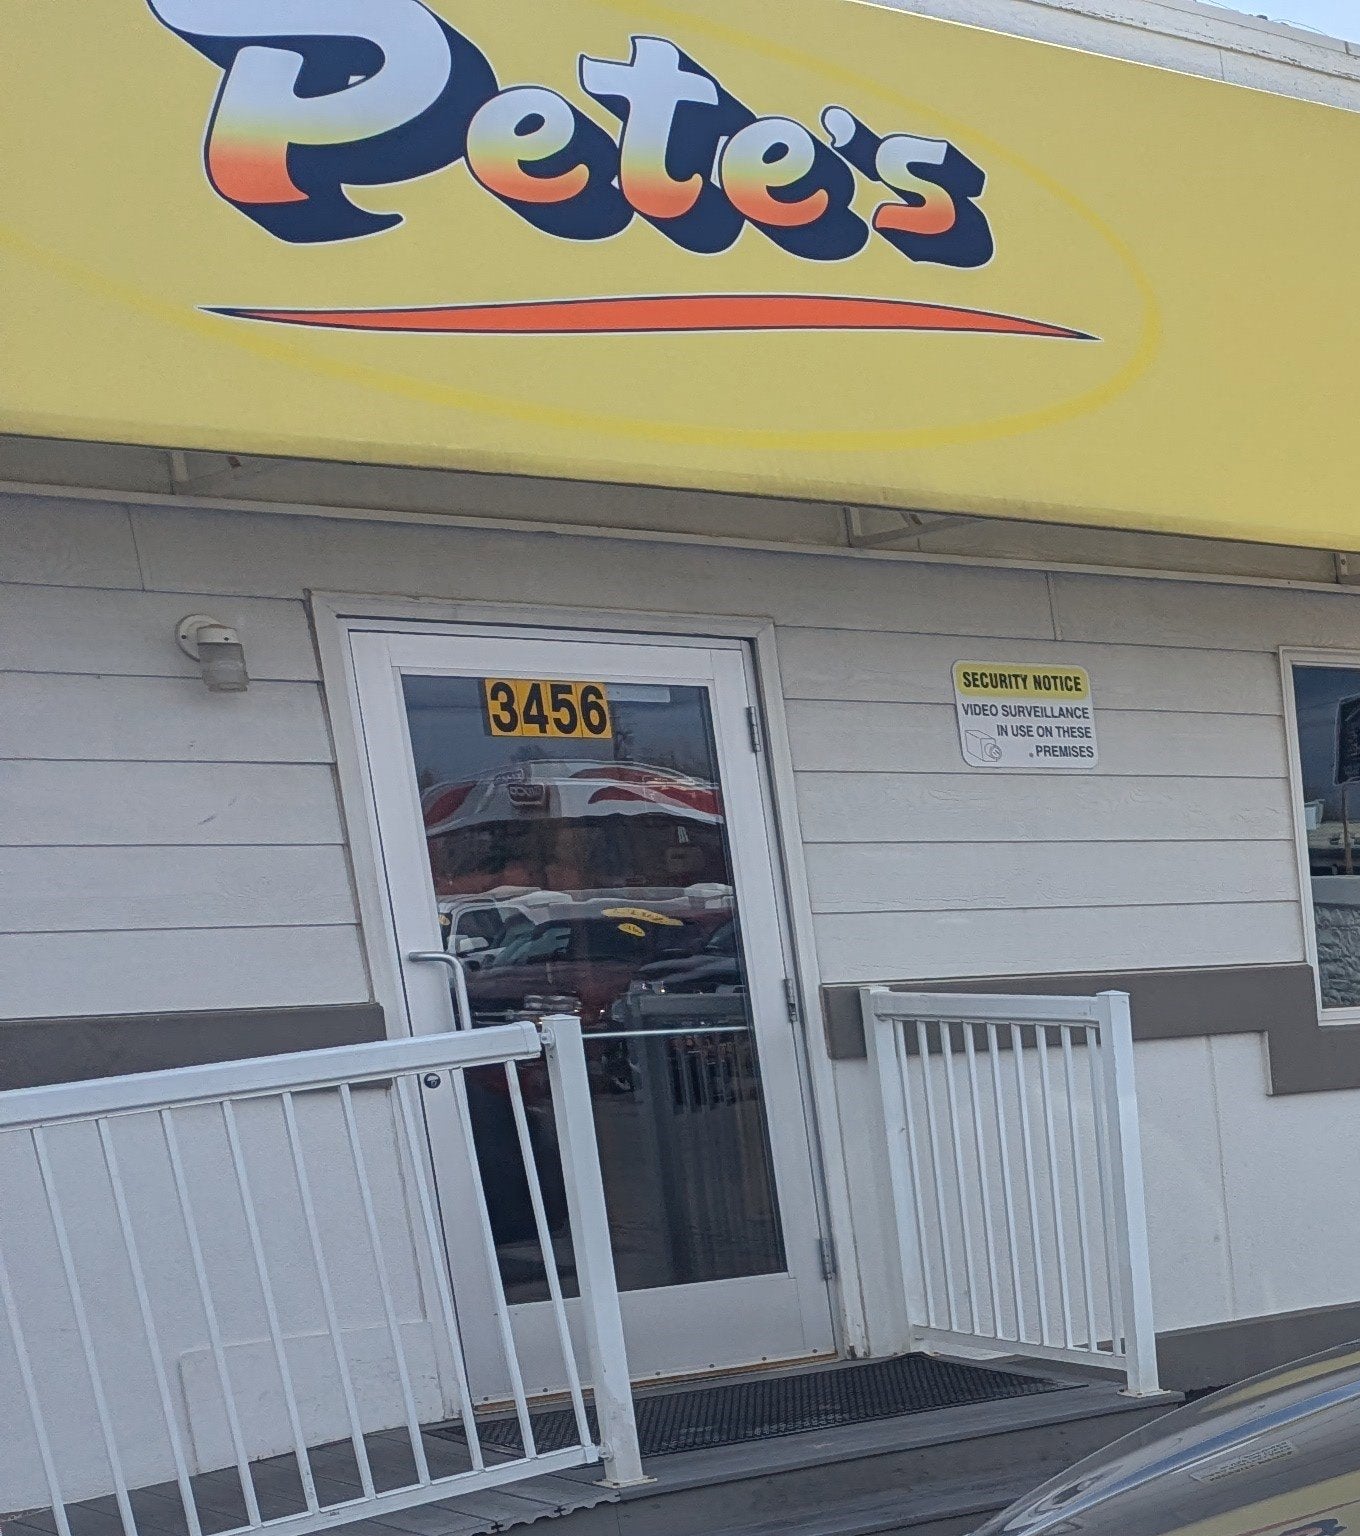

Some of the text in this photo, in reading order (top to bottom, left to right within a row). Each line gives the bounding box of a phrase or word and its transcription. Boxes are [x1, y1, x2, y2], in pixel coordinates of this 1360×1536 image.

[143, 0, 995, 270] Pete's
[962, 671, 1082, 692] SECURITY NOTICE
[490, 681, 607, 735] 3456
[961, 703, 1090, 719] VIDEO SURVEILLANCE
[996, 724, 1092, 739] IN USE ON THESE
[1035, 745, 1094, 758] PREMISES
